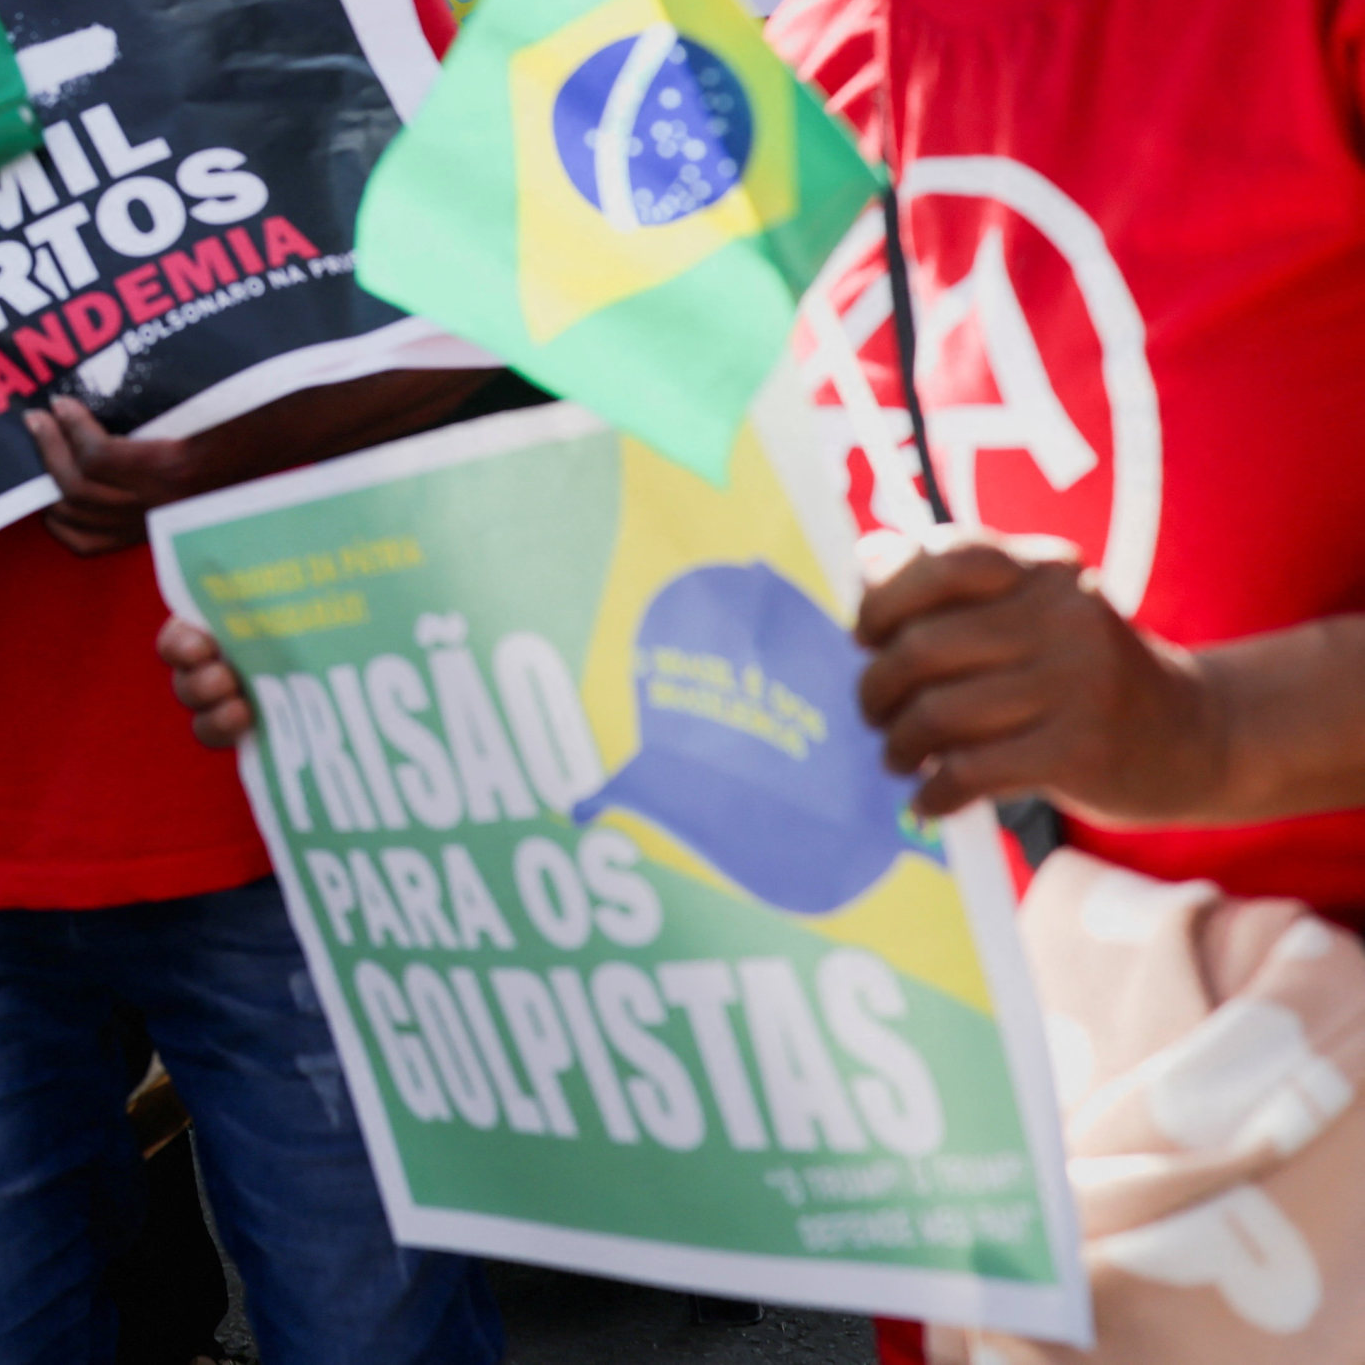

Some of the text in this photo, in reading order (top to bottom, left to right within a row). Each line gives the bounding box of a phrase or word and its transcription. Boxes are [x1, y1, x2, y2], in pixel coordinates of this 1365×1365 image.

[122, 275, 266, 355] BOLSONARO
[266, 264, 308, 290] NA
[253, 611, 606, 833] PRISÃO
[303, 827, 664, 951] PARA OS
[353, 946, 945, 1155] GOLPISTAS
